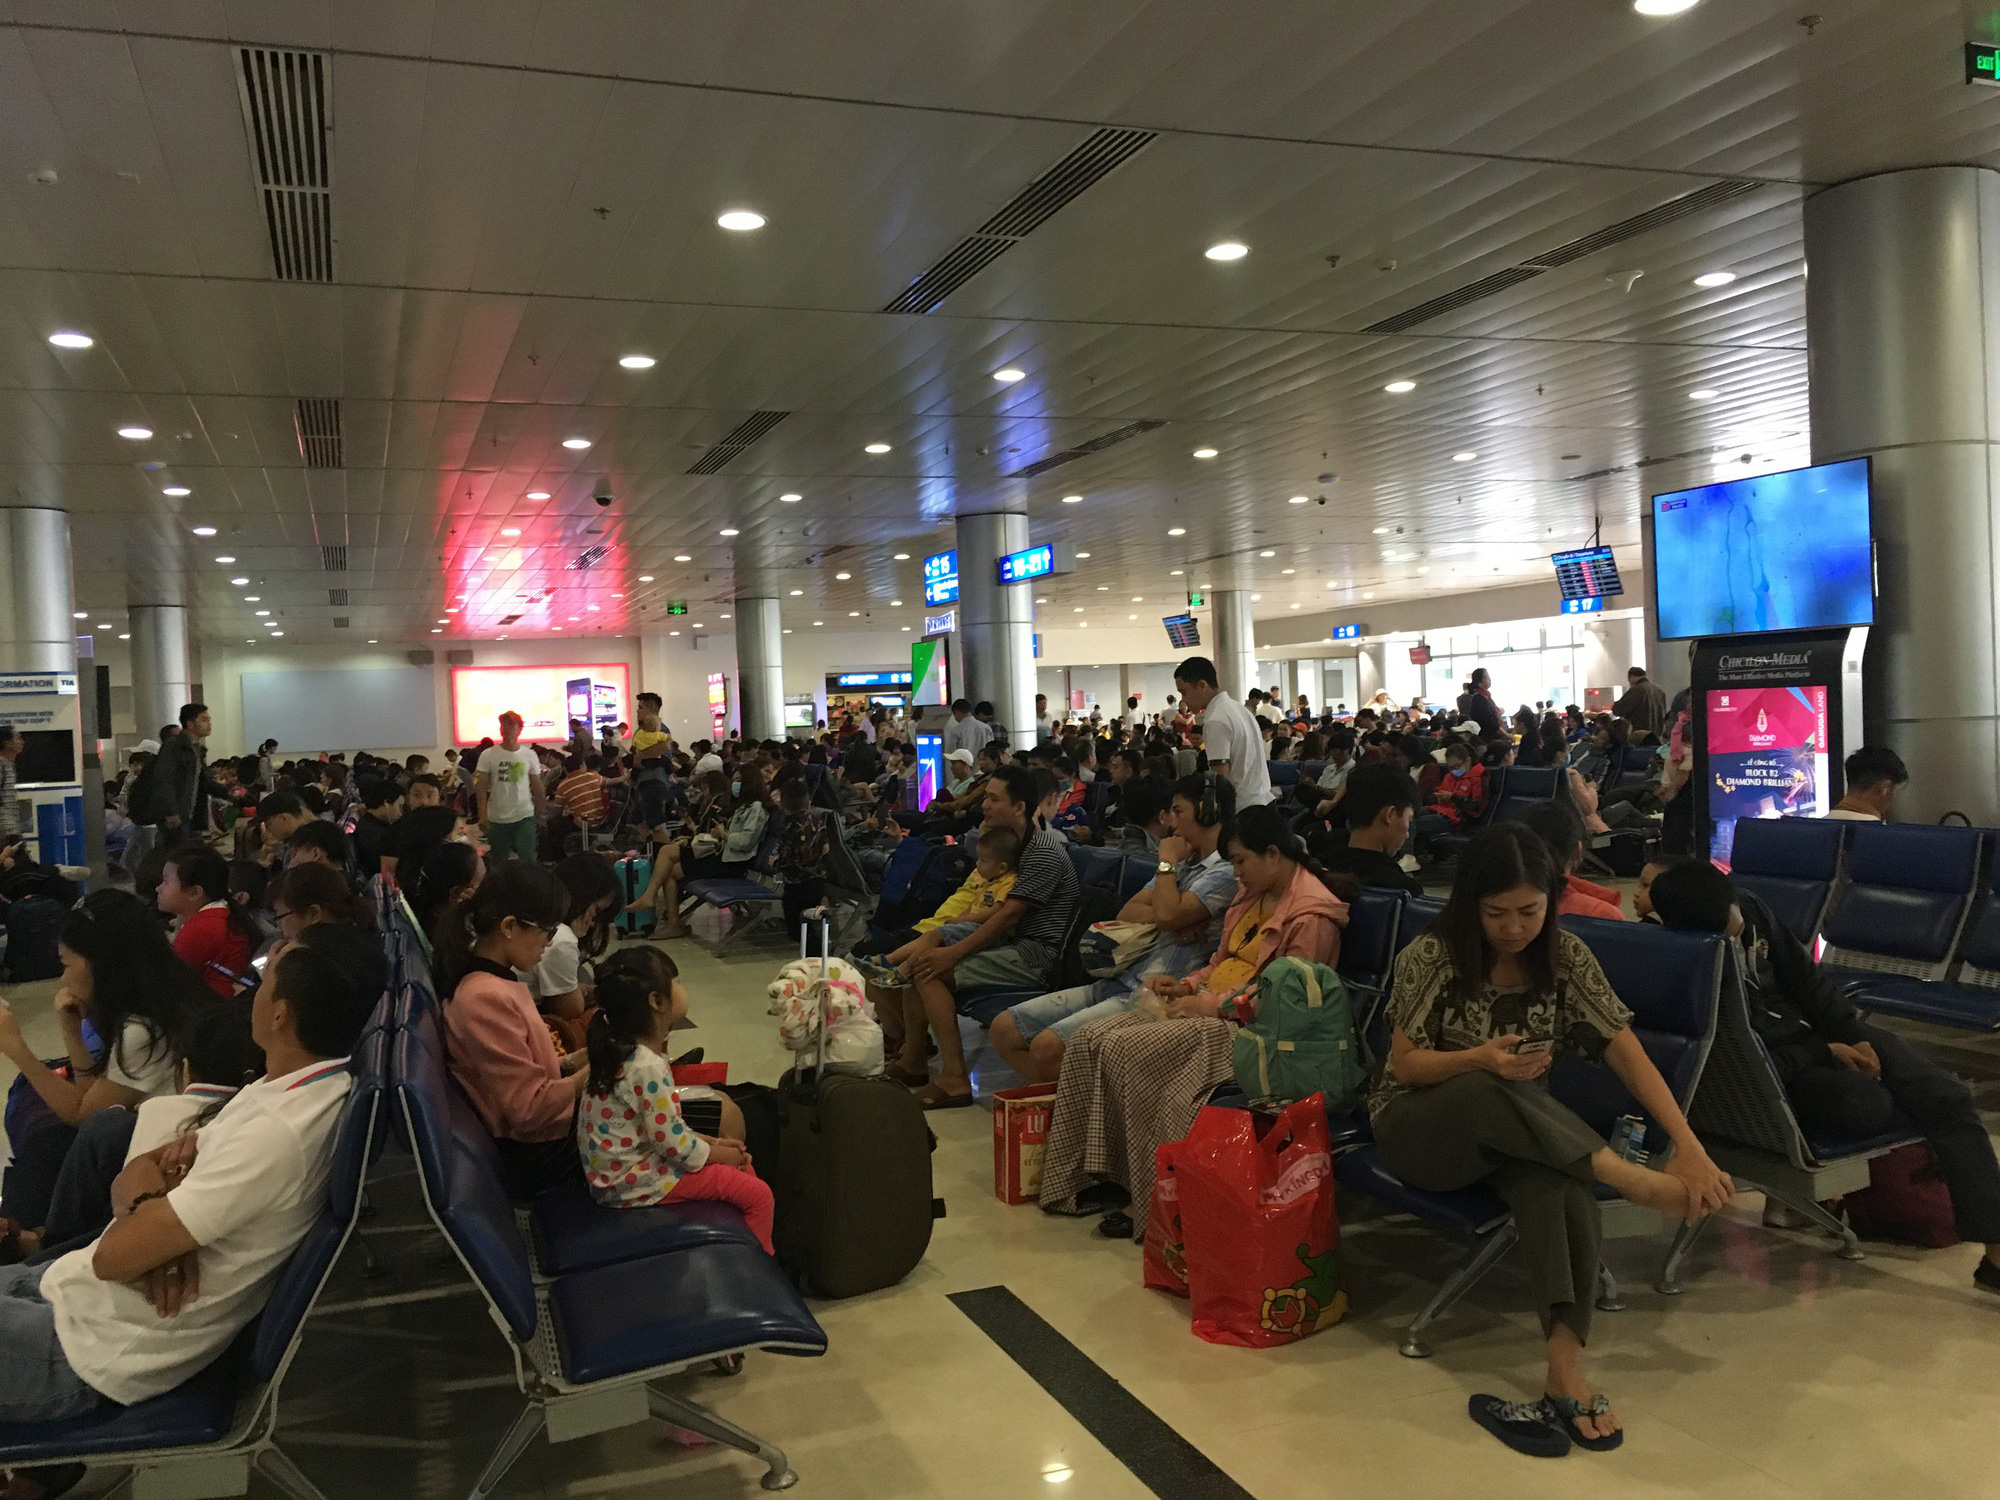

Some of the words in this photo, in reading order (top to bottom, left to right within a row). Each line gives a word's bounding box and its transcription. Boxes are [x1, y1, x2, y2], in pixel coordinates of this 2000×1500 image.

[1749, 734, 1776, 742] DIAMOND
[1745, 768, 1768, 778] BLOCK
[1769, 768, 1779, 778] B2
[1726, 777, 1761, 786] DIAMOND
[1028, 1115, 1045, 1134] LU
